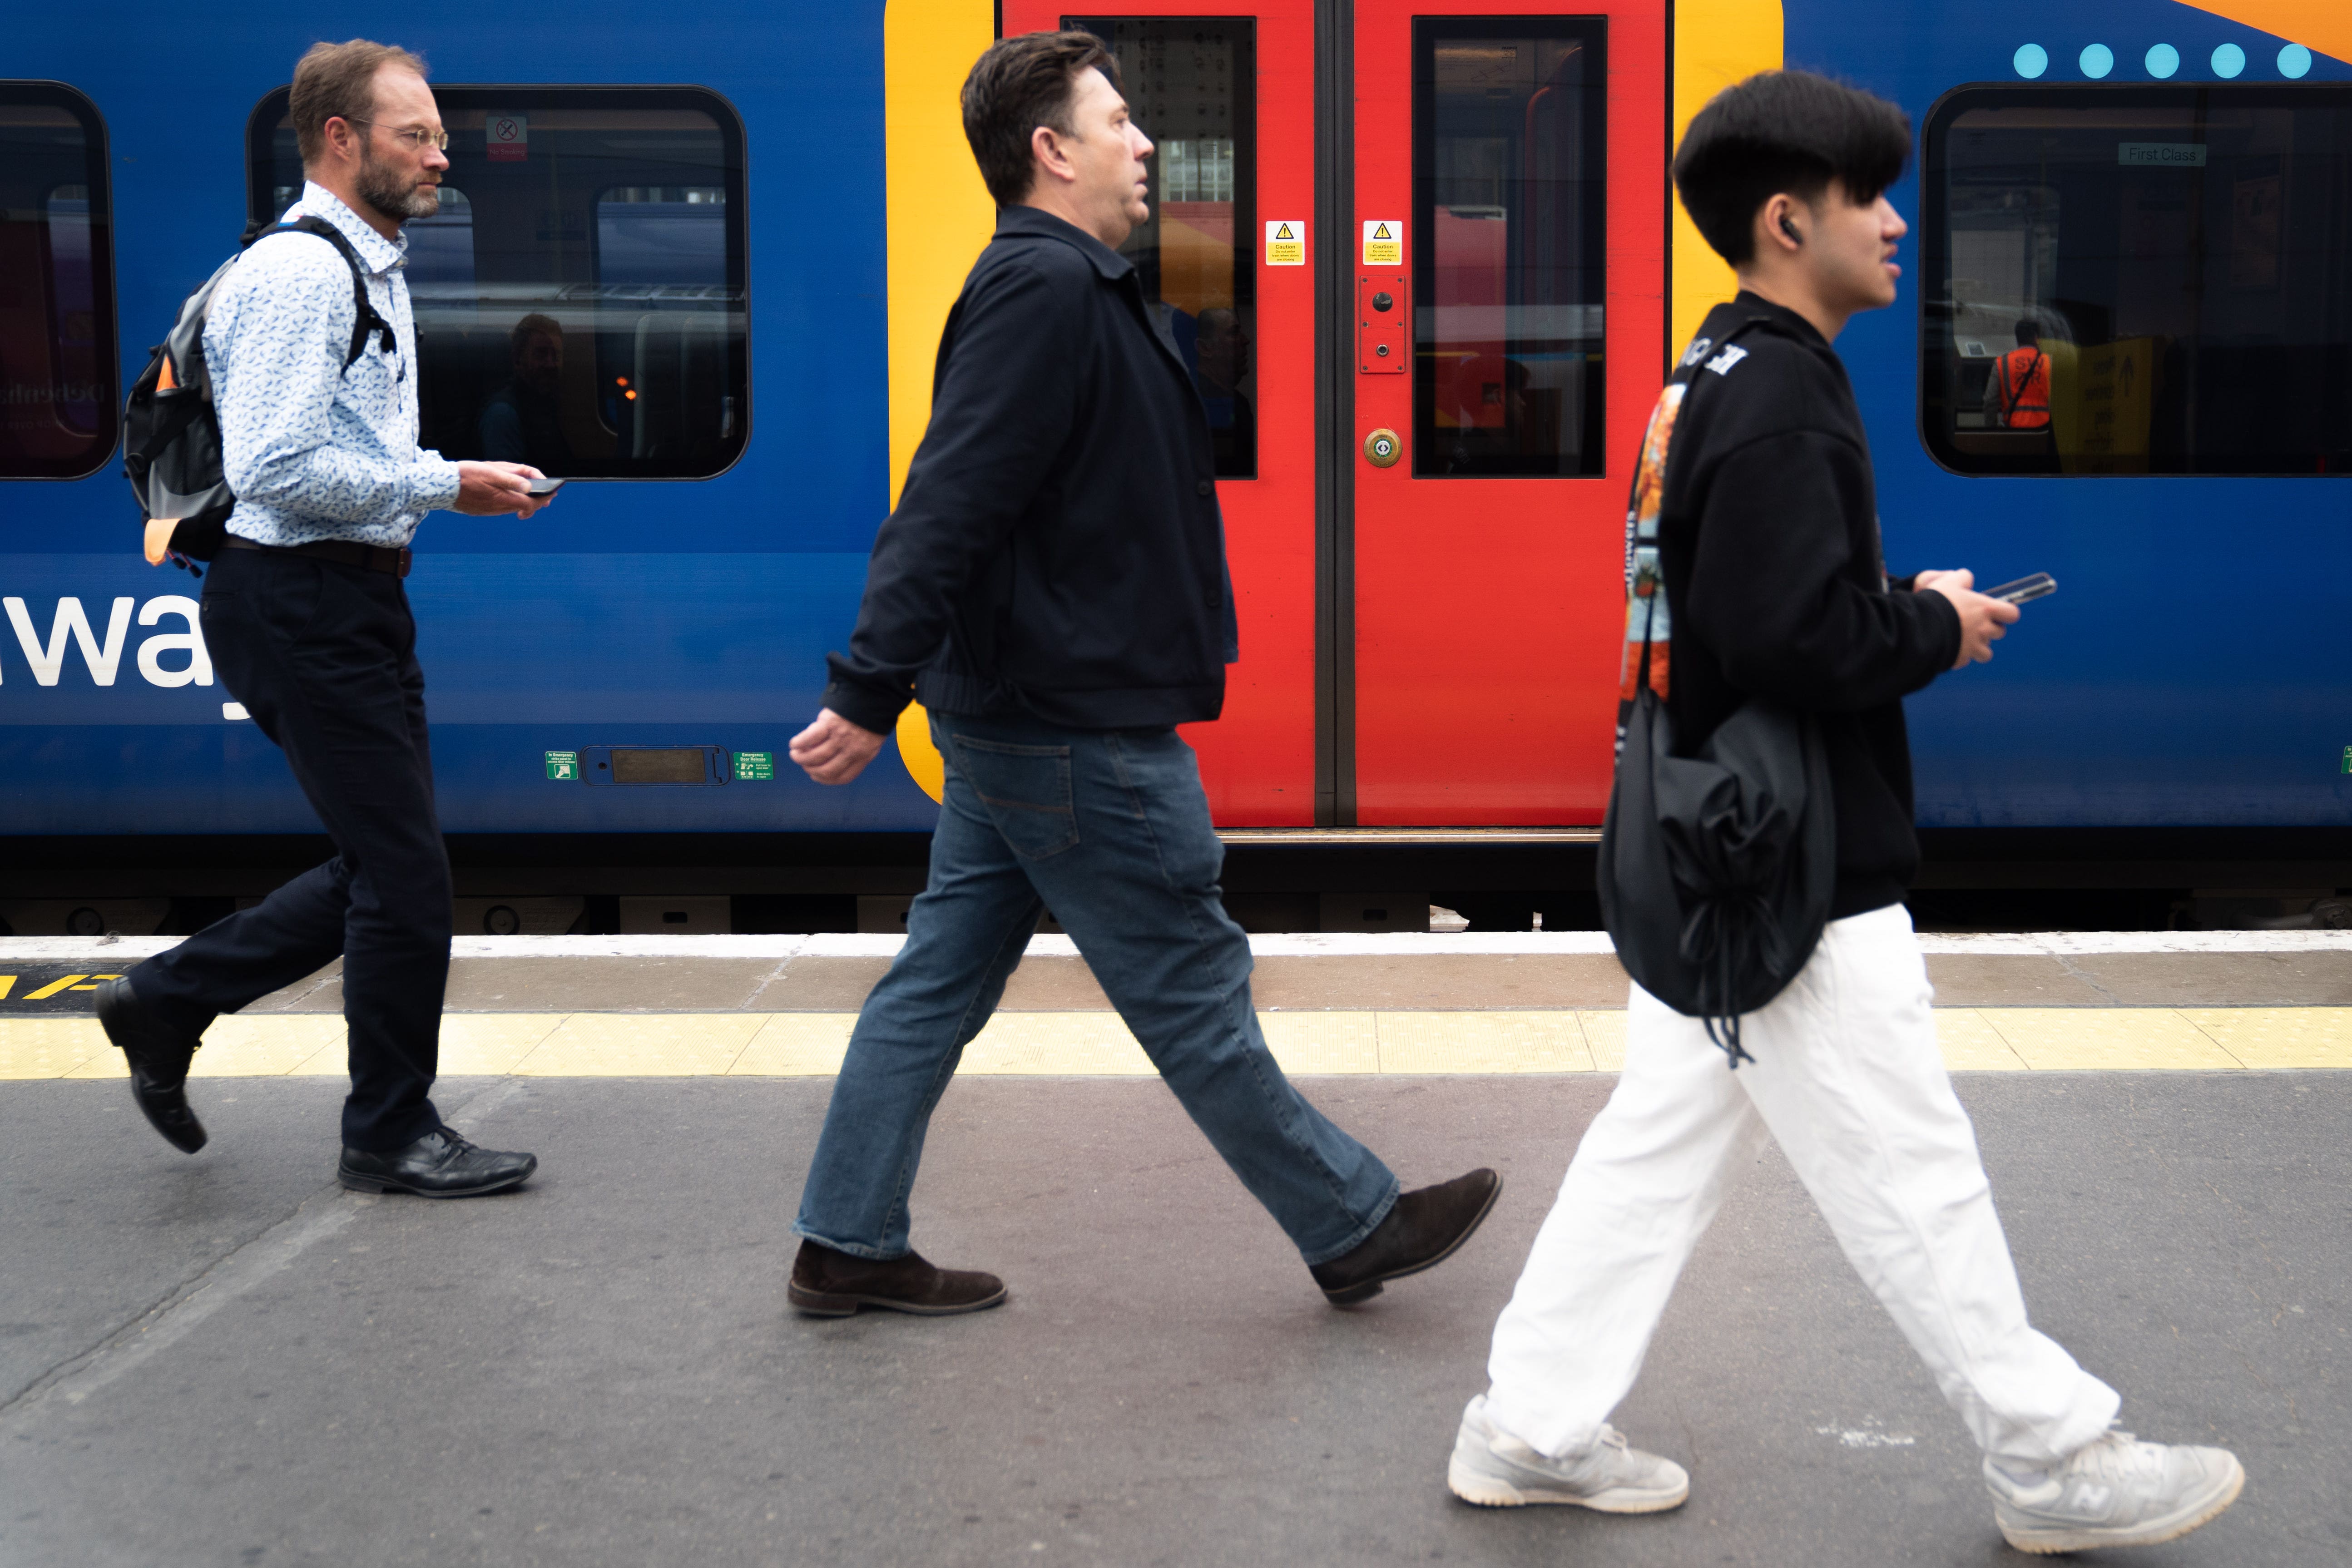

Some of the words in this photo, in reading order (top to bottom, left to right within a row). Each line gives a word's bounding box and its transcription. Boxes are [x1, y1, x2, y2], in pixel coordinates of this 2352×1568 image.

[501, 148, 525, 157] Smoking
[2129, 148, 2158, 160] First
[2162, 148, 2196, 162] Class
[0, 595, 251, 720] wa
